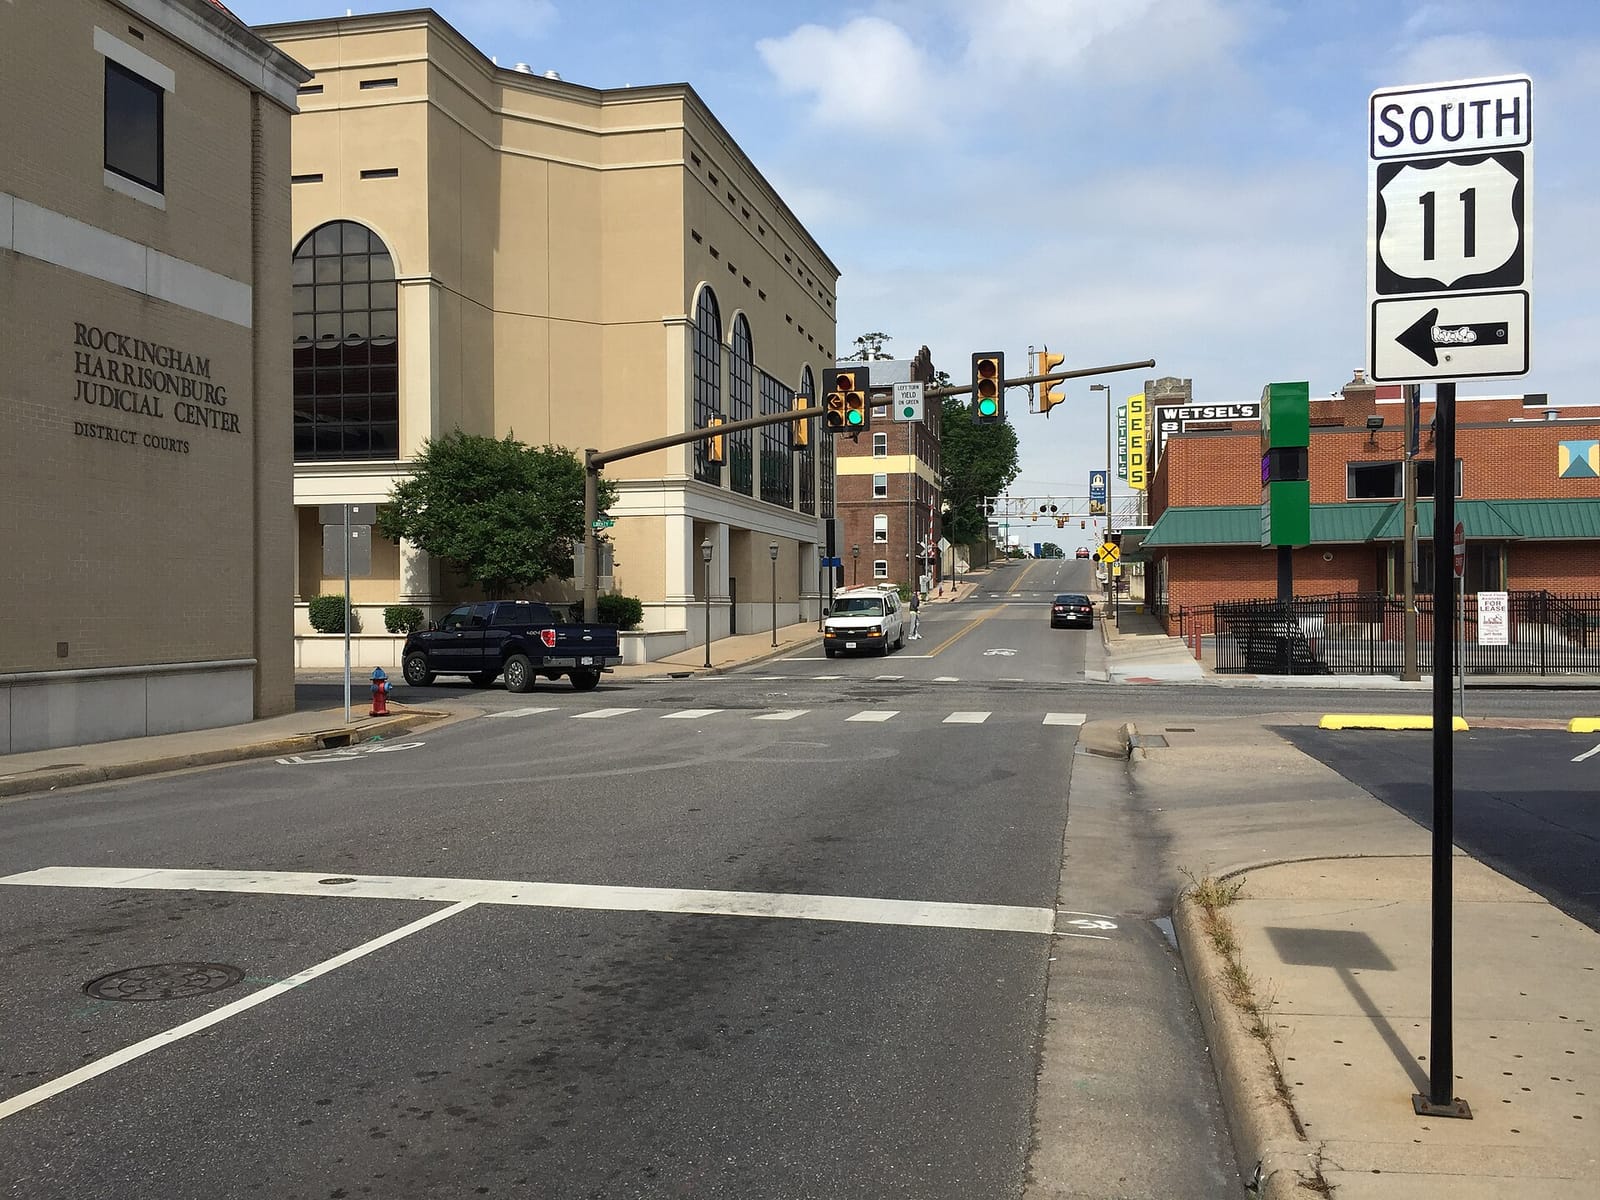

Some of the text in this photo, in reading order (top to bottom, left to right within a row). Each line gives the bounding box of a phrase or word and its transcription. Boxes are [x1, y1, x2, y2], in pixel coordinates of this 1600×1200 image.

[1377, 96, 1521, 148] SOUTH
[1418, 187, 1476, 261] 11
[73, 322, 211, 379] ROCKINGHAM
[73, 351, 228, 407] HARRISONBURG
[73, 379, 242, 434] JUDICIAL CENTER
[73, 421, 190, 454] DISTRICT COURTS
[1163, 404, 1254, 419] WETSEL'S
[1131, 400, 1143, 483] SEEDS
